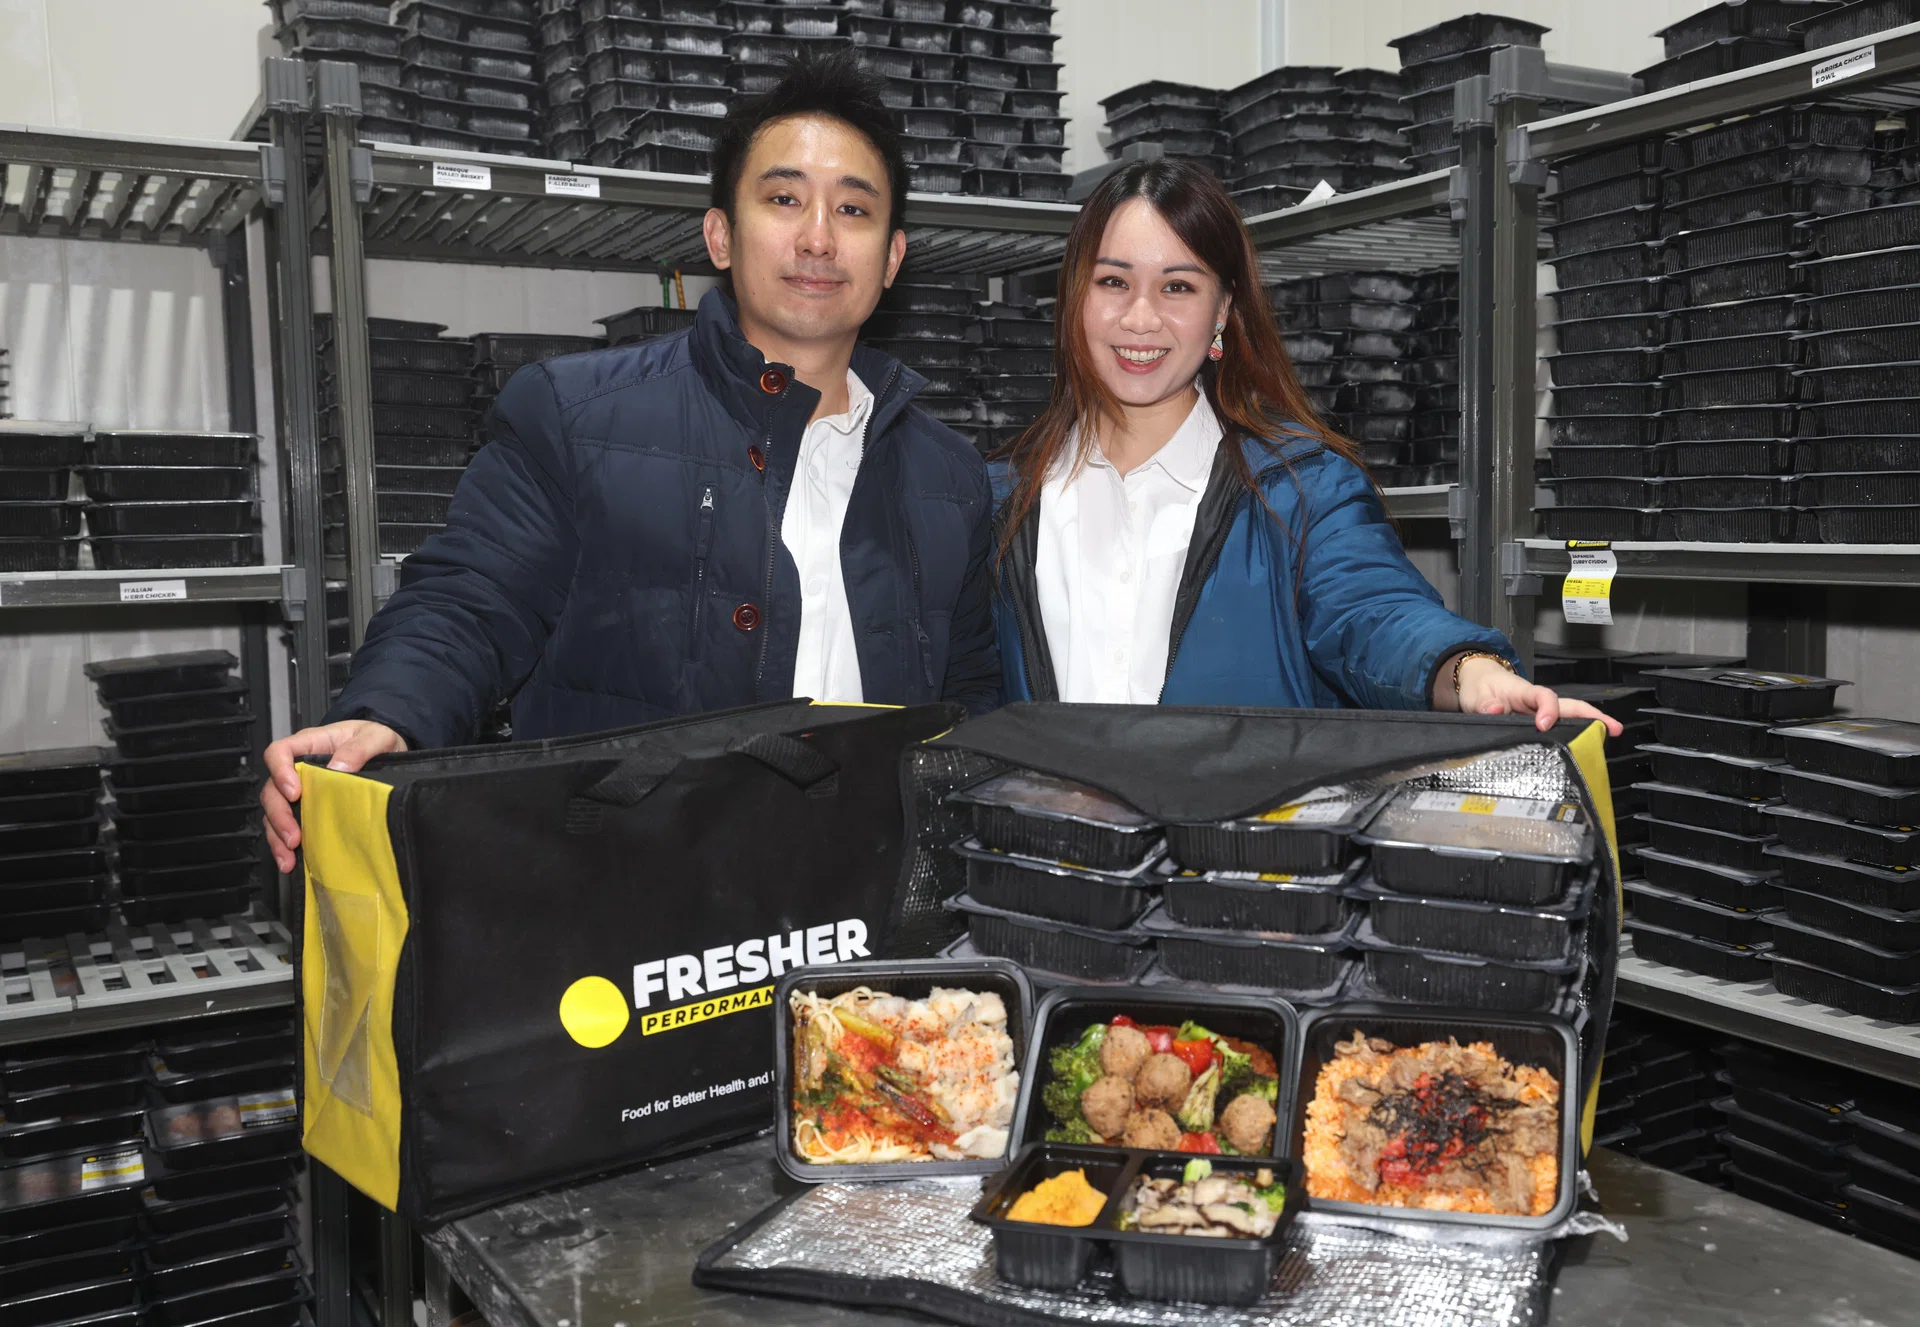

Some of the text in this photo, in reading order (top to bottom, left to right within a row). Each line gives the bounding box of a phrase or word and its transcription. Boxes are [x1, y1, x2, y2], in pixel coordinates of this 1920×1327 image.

[1815, 50, 1872, 76] HARRISA CHICKEN
[1815, 72, 1836, 84] BOWL
[145, 592, 177, 600] CHICKEN
[633, 918, 872, 1009] FRESHER
[621, 1103, 651, 1122] Food
[654, 1099, 670, 1113] for
[672, 1089, 707, 1108] Better
[709, 1078, 746, 1098] Health
[748, 1071, 769, 1088] and
